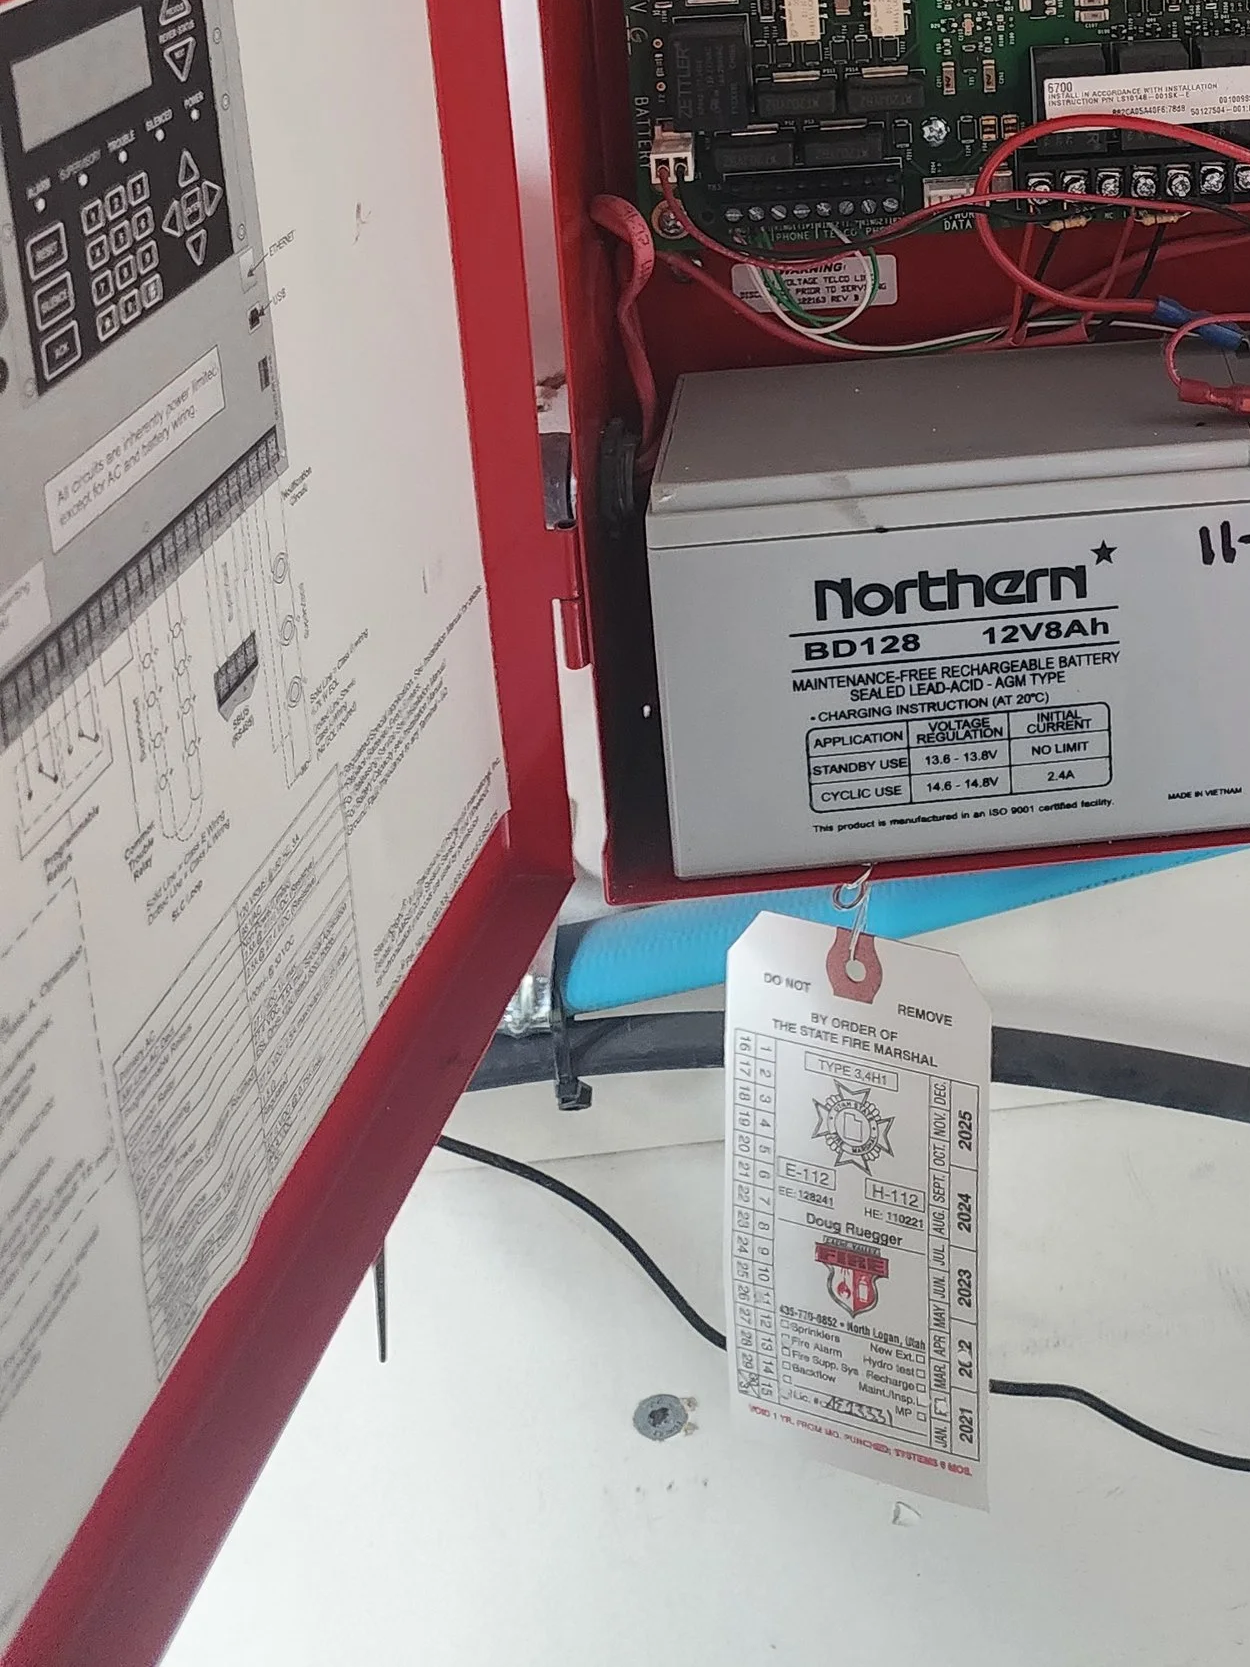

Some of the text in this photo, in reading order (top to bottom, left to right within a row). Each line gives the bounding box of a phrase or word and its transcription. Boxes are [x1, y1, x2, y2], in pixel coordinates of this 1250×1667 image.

[1047, 82, 1073, 94] 6700
[1091, 88, 1141, 97] ACCORDANCE
[1144, 85, 1163, 93] WITH
[1165, 83, 1218, 92] INSTALLATION
[633, 96, 652, 170] BATTERY
[943, 219, 974, 231] DATA
[814, 564, 1088, 621] Northern
[804, 617, 1109, 661] BD128 12V8Ah
[792, 651, 1121, 692] MAINTENANCE-FREE RECHARGEABLE BATTERY
[850, 670, 1066, 702] SEALED LEAD-ACID AGM TYPE
[818, 705, 892, 723] CHARGING
[896, 697, 989, 717] INSTRUCTION
[992, 695, 1014, 710] (AT
[1037, 710, 1082, 722] INITIAL
[916, 727, 1003, 744] REGULATION
[928, 717, 990, 732] VOLTAGE
[1027, 718, 1092, 734] CURRENT
[813, 730, 903, 749] APPLICATION
[1031, 740, 1089, 756] NO LIMIT
[812, 756, 909, 776] STANDBY USE
[925, 750, 998, 766] 13.6 13.8V
[927, 777, 999, 792] 14.6 14.8V
[1047, 769, 1075, 782] 2.4A
[821, 785, 902, 803] CYCLIC USE
[1168, 787, 1242, 800] MADE IN VIETNAM
[813, 798, 1115, 834] This product is manufactured in an ISO 9001 certified facility.
[764, 972, 812, 993] DO NOT
[897, 1003, 953, 1027] REMOVE
[811, 1012, 898, 1042] BY ORDER OF
[772, 1018, 938, 1068] THE STATE FIRE MARSHAL
[818, 1059, 851, 1076] TYPE
[934, 1082, 947, 1106] DEC.
[933, 1113, 946, 1136] NOV.
[958, 1110, 973, 1151] 2025
[933, 1144, 946, 1166] OCT.
[786, 1163, 829, 1185] E-112
[778, 1186, 834, 1206] EE: 128241
[872, 1184, 919, 1208] H-112
[933, 1174, 945, 1203] SEPT.
[864, 1207, 924, 1228] HE: 110221
[957, 1193, 972, 1233] 2024
[806, 1212, 842, 1234] Doug
[846, 1223, 903, 1247] Ruegger
[957, 1269, 972, 1308] 2023
[934, 1304, 946, 1328] MAY
[792, 1335, 843, 1358] Fire Alarm
[935, 1425, 948, 1448] JAN.
[959, 1407, 974, 1444] 2021
